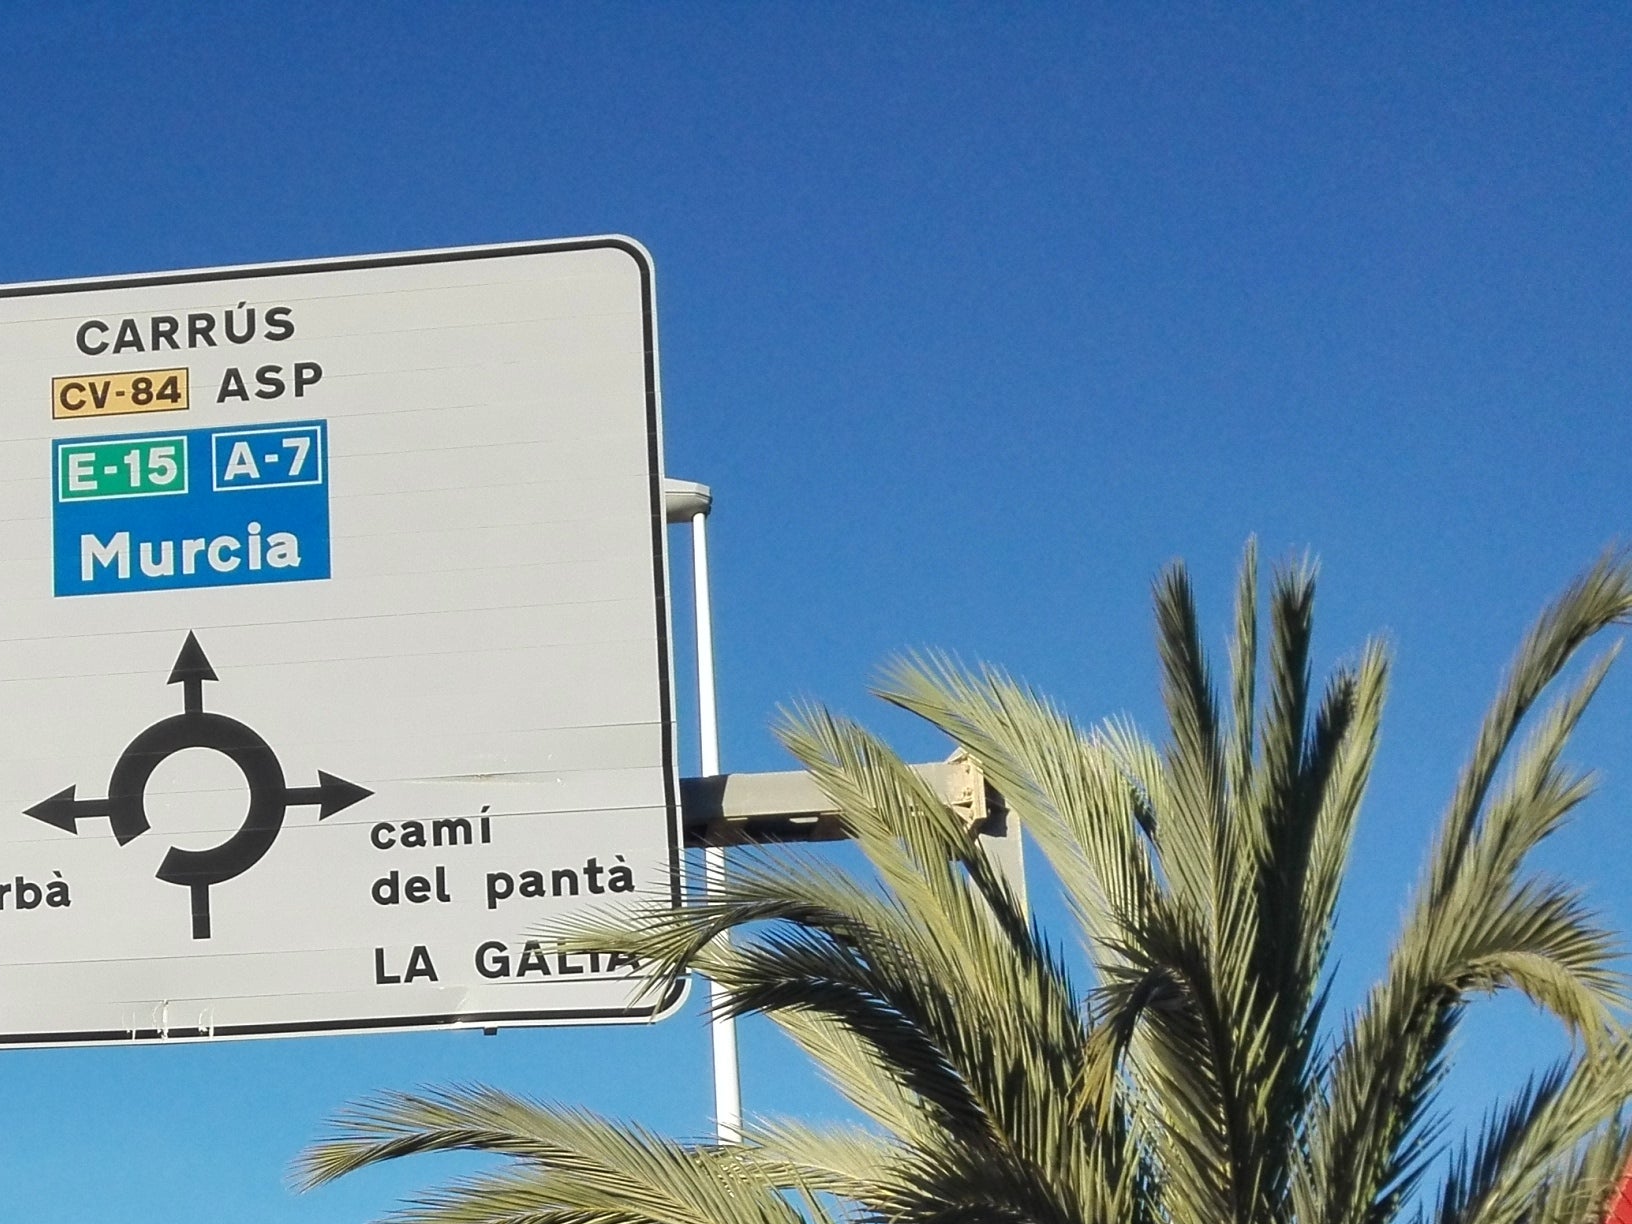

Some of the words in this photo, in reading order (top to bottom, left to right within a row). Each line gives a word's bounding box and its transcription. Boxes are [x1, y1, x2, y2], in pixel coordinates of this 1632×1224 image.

[77, 302, 294, 355] CARRÚS
[59, 375, 182, 411] CV-84
[217, 362, 322, 403] ASP
[68, 446, 178, 491] E-15
[223, 436, 311, 481] A-7
[80, 521, 301, 581] Murcia
[371, 806, 490, 849] camí
[372, 867, 450, 905] del
[487, 855, 634, 909] pantà
[376, 946, 438, 984] LA
